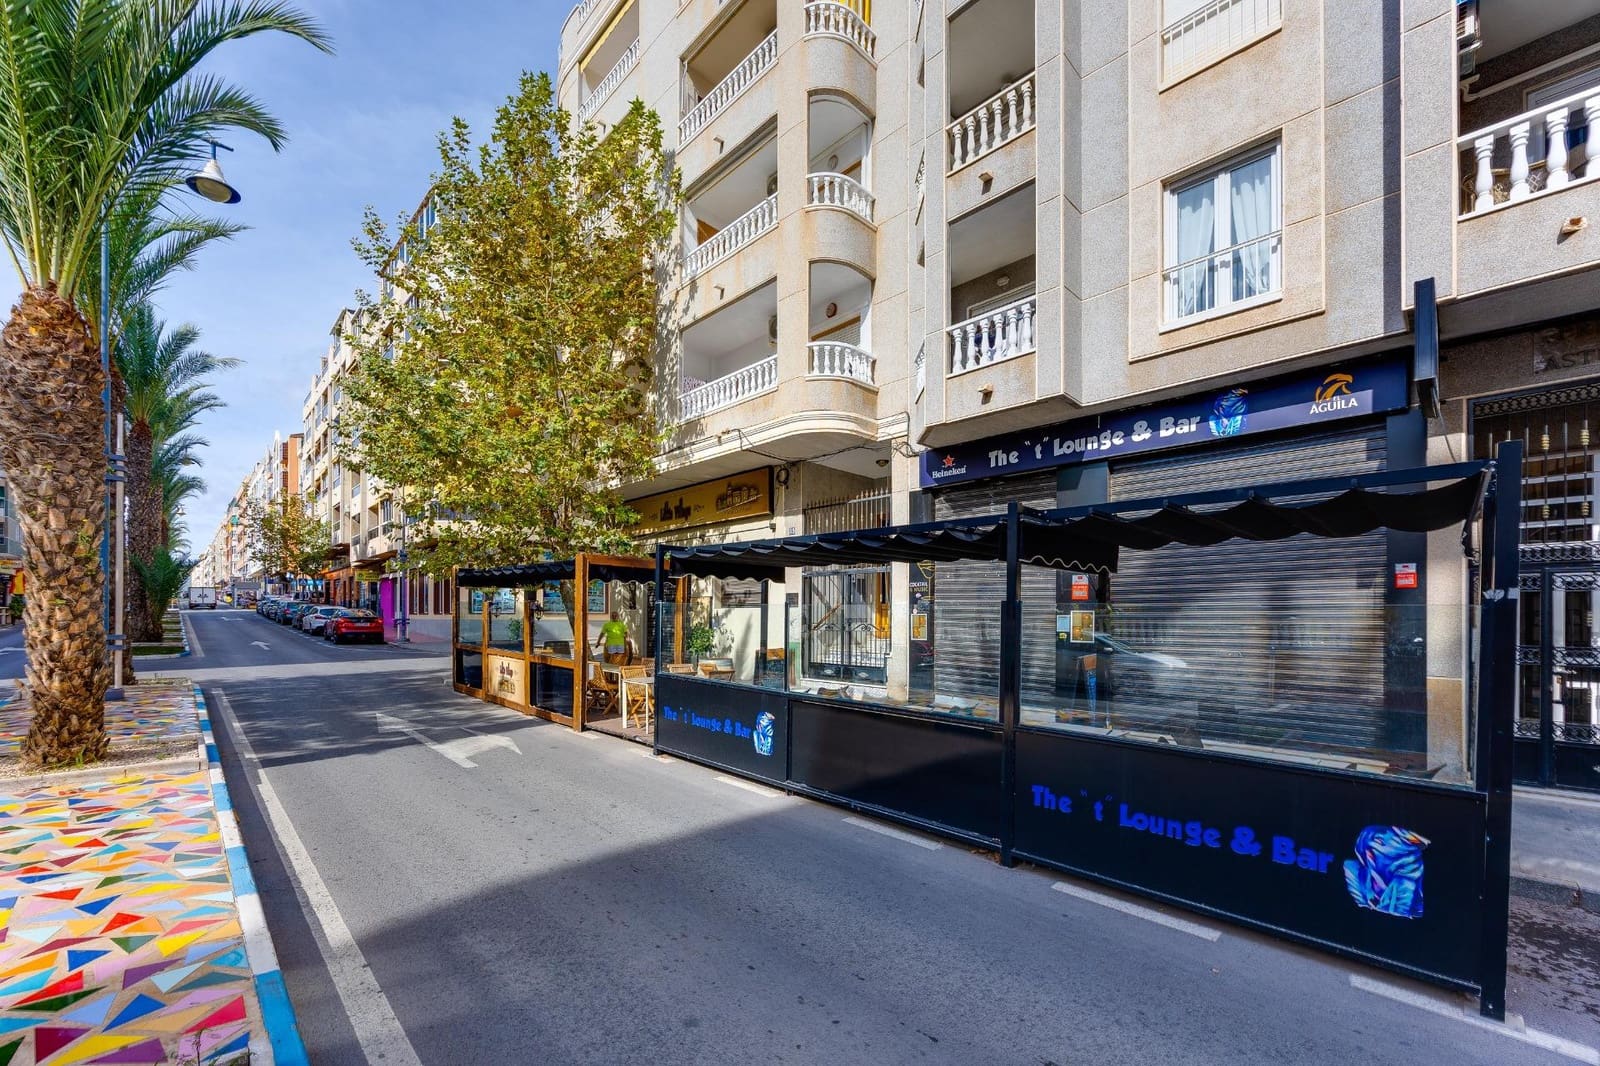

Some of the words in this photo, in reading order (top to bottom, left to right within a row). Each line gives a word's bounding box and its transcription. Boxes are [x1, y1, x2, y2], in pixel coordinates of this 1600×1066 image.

[988, 449, 1019, 468] The
[1053, 430, 1124, 457] Lounge
[1132, 420, 1152, 442] &
[1160, 412, 1201, 437] Bar
[932, 466, 966, 478] Heineken
[664, 706, 677, 720] The
[692, 712, 721, 731] Lounge
[724, 719, 733, 733] &
[735, 722, 750, 738] Bar
[1032, 784, 1073, 814] The
[1119, 803, 1222, 849] Lounge
[1230, 826, 1262, 857] &
[1272, 834, 1334, 874] Bar
